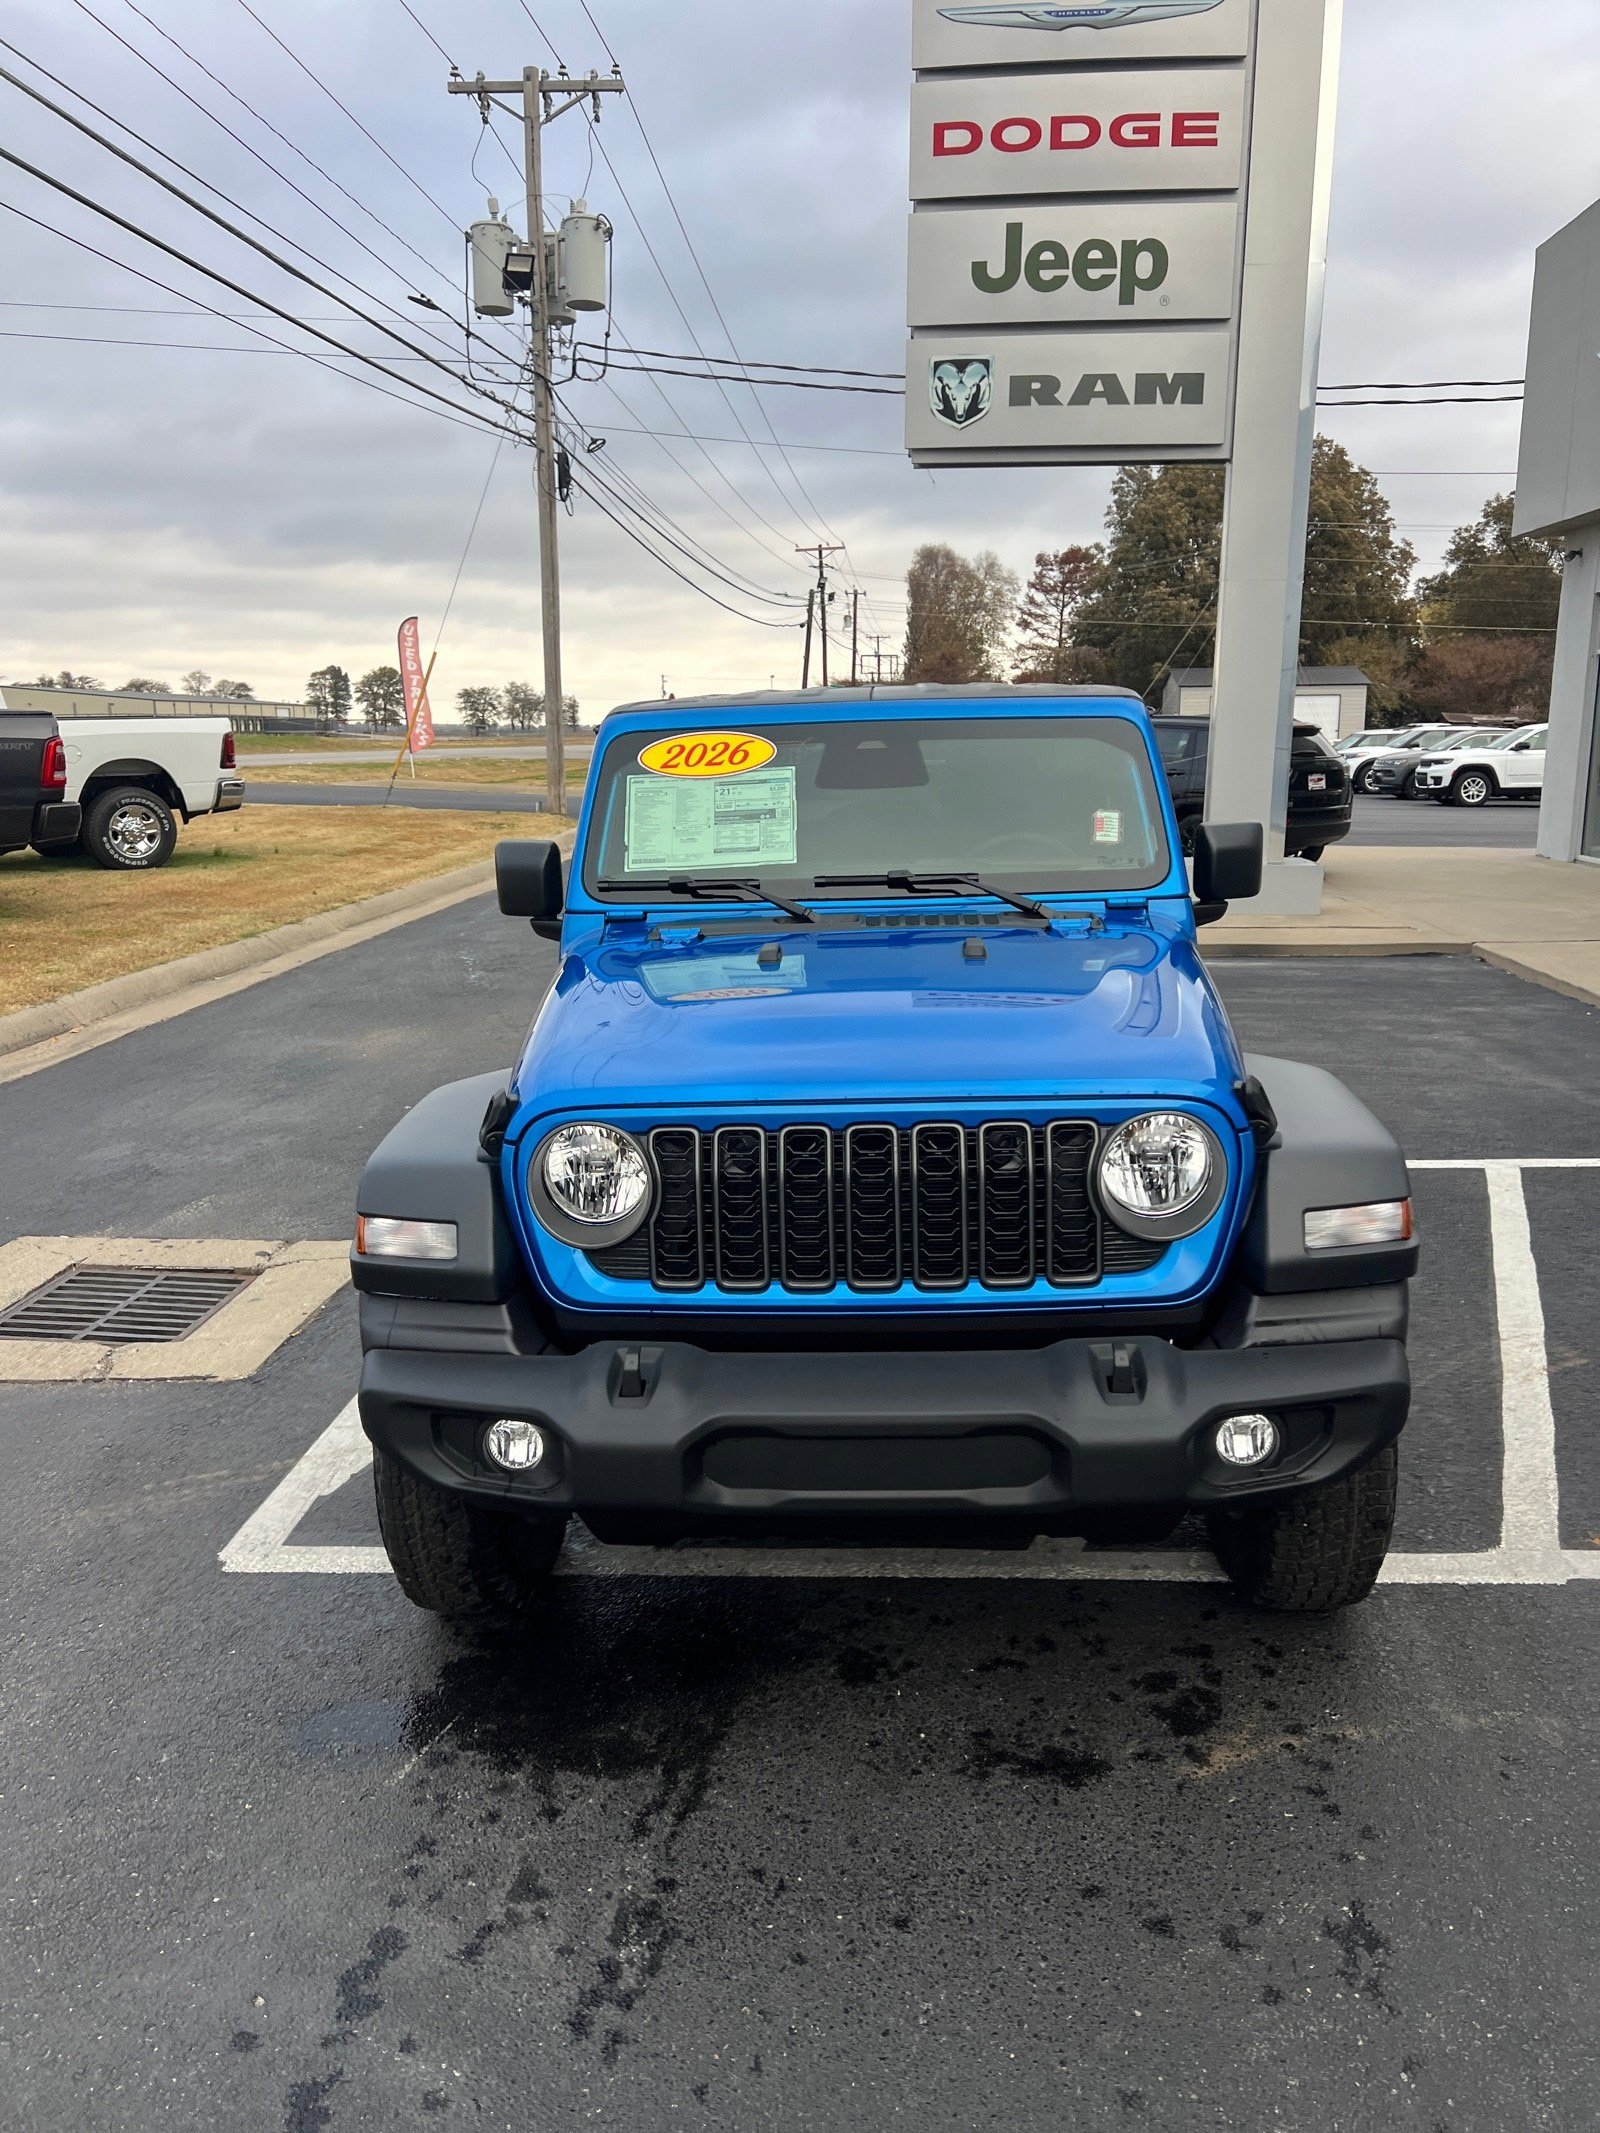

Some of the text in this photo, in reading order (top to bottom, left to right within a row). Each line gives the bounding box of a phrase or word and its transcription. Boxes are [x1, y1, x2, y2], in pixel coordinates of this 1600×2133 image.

[1051, 9, 1107, 17] CHRYSLER
[933, 112, 1219, 157] DODGE
[971, 222, 1169, 305] Jeep
[1008, 372, 1205, 407] RAM
[403, 623, 417, 671] USED
[660, 740, 755, 769] 2026
